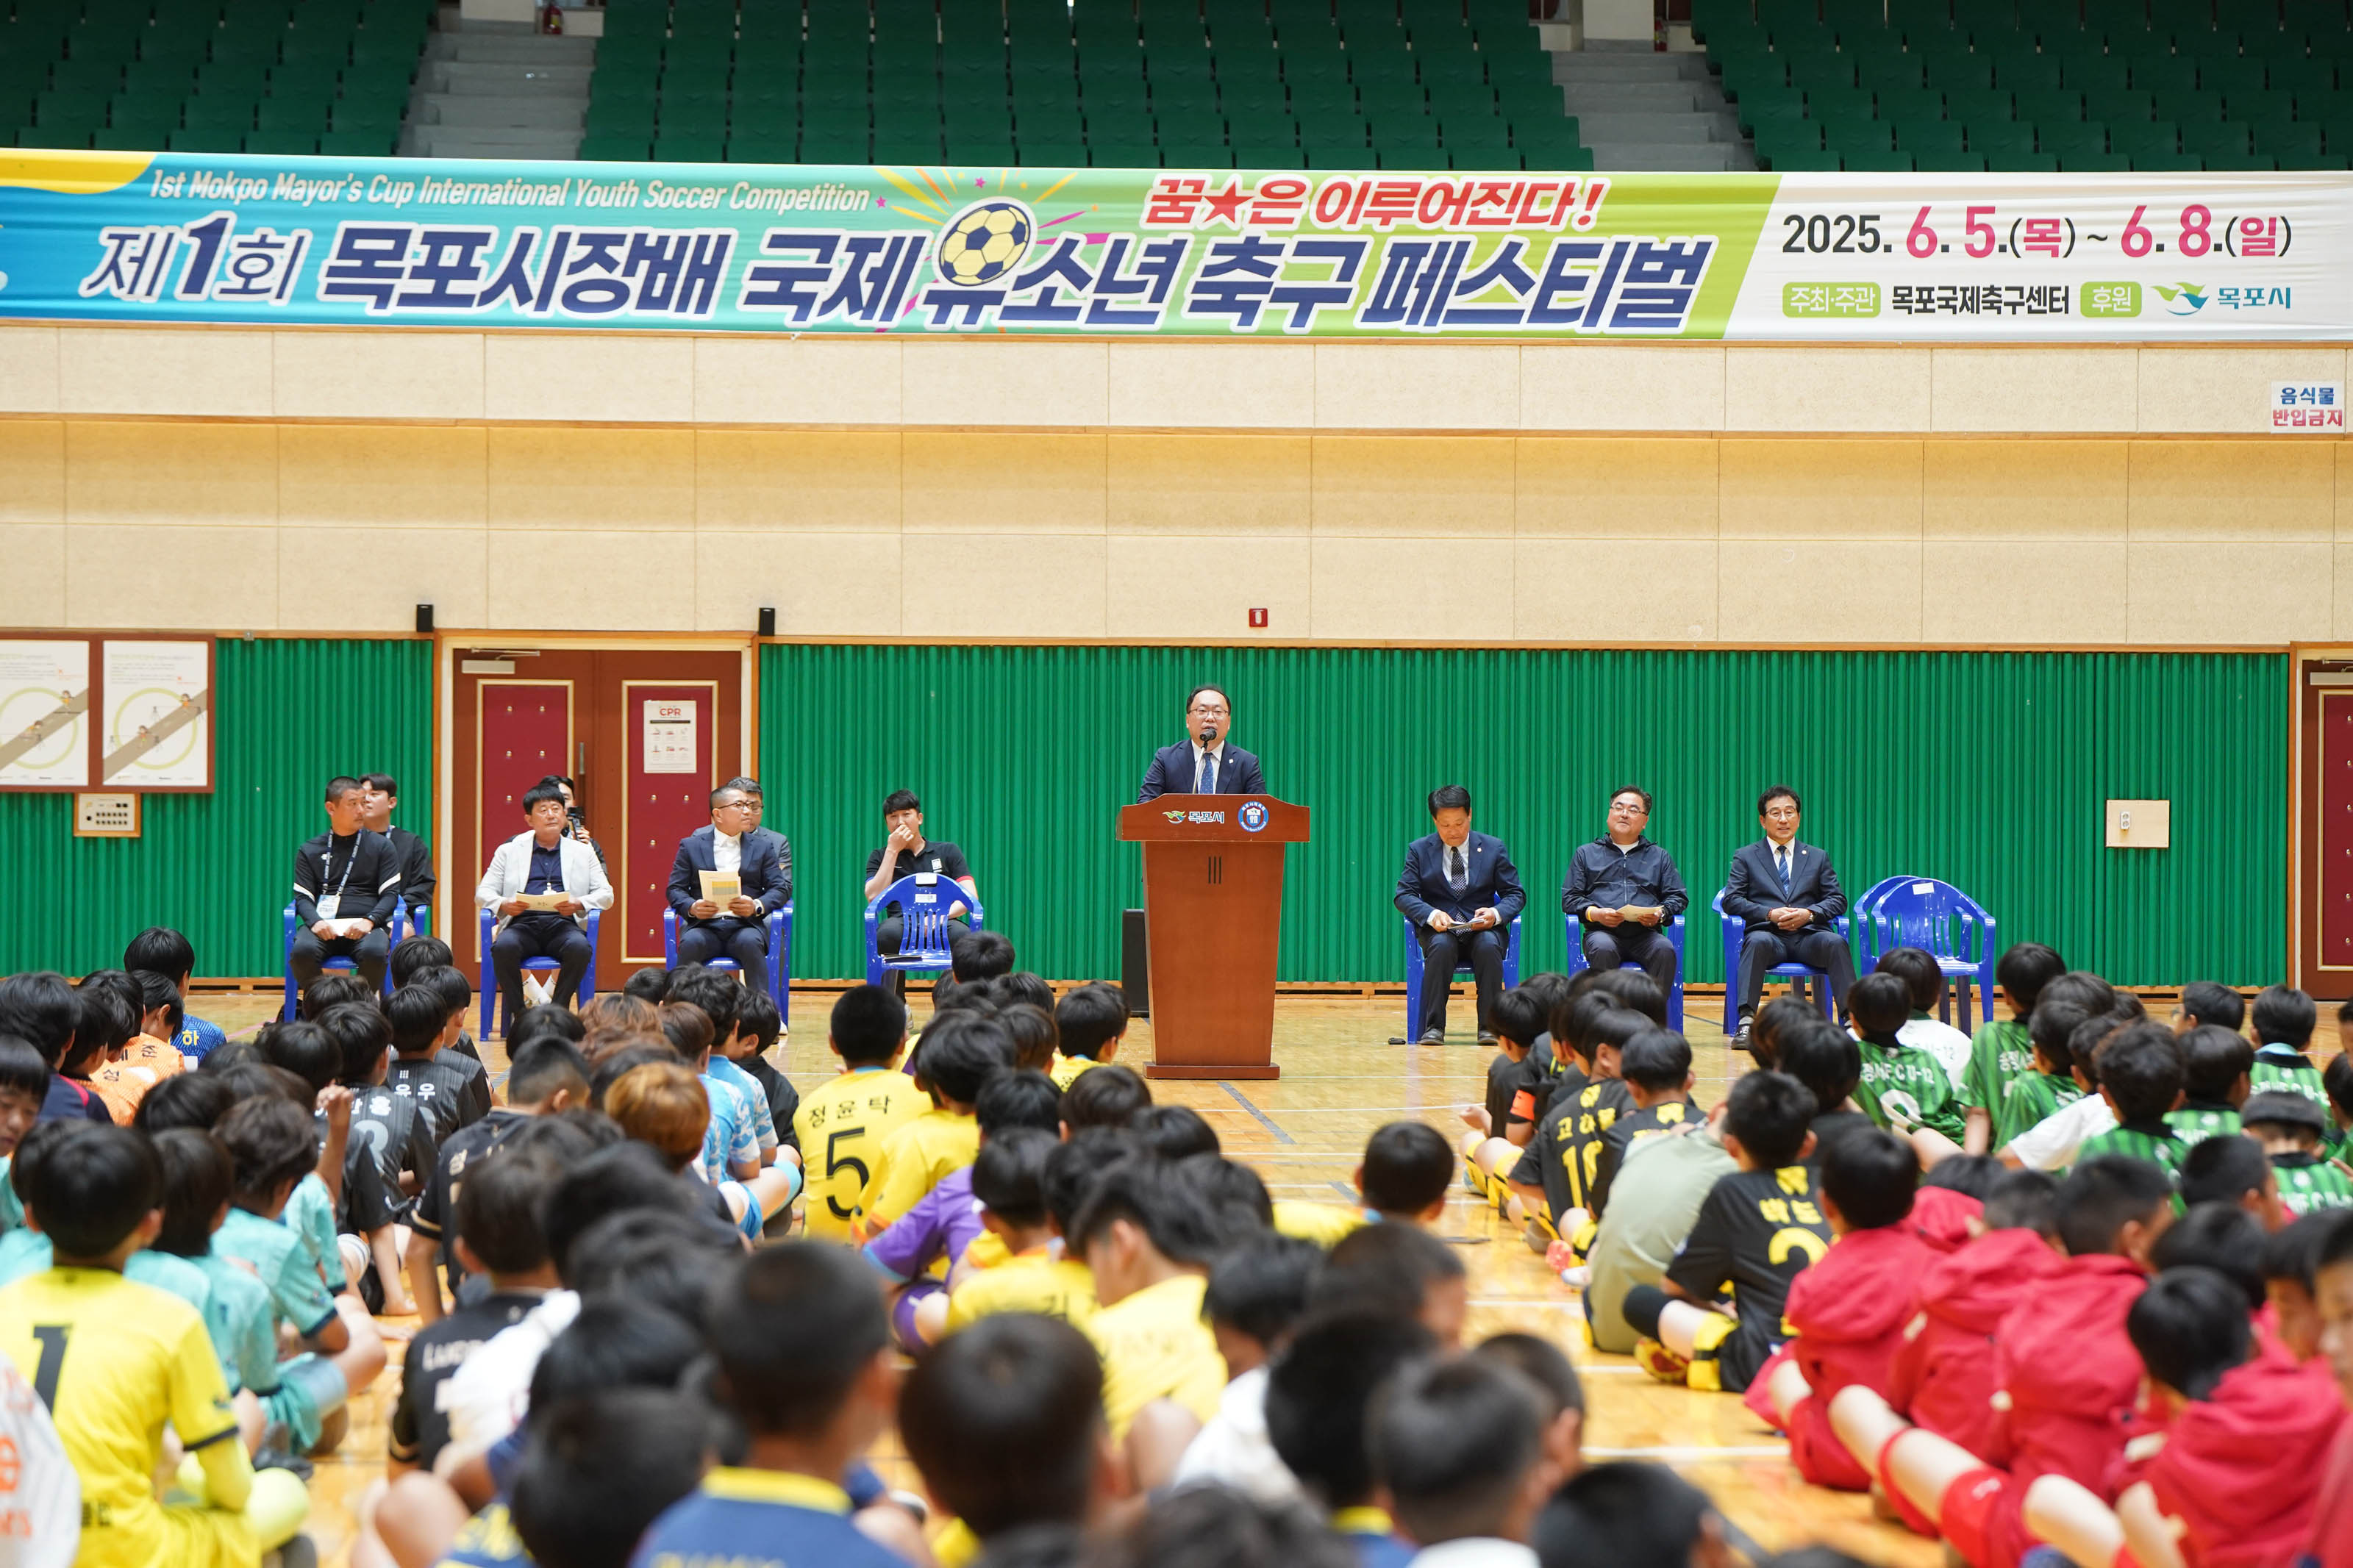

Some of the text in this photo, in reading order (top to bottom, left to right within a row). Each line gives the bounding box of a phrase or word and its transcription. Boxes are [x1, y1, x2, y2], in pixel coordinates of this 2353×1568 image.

[151, 169, 871, 216] 1st Mokpo Mayor's Cup International Youth Soccer Competition
[1315, 180, 1604, 227] 이루어진다!
[1782, 214, 1893, 254] 2025.
[86, 216, 304, 300] 제1회
[322, 226, 732, 317] 목포시장배
[1188, 235, 1365, 329] 축구
[1363, 240, 1713, 329] 페스티벌
[1891, 285, 2070, 315] 목포국제축구센터
[2091, 284, 2132, 313] 후원
[2217, 285, 2291, 309] 목포시
[2279, 386, 2335, 406] 음식물
[2271, 408, 2343, 428] 반입금지
[660, 708, 681, 716] CPR
[1188, 812, 1225, 824] 목포시
[826, 1126, 870, 1221] 5
